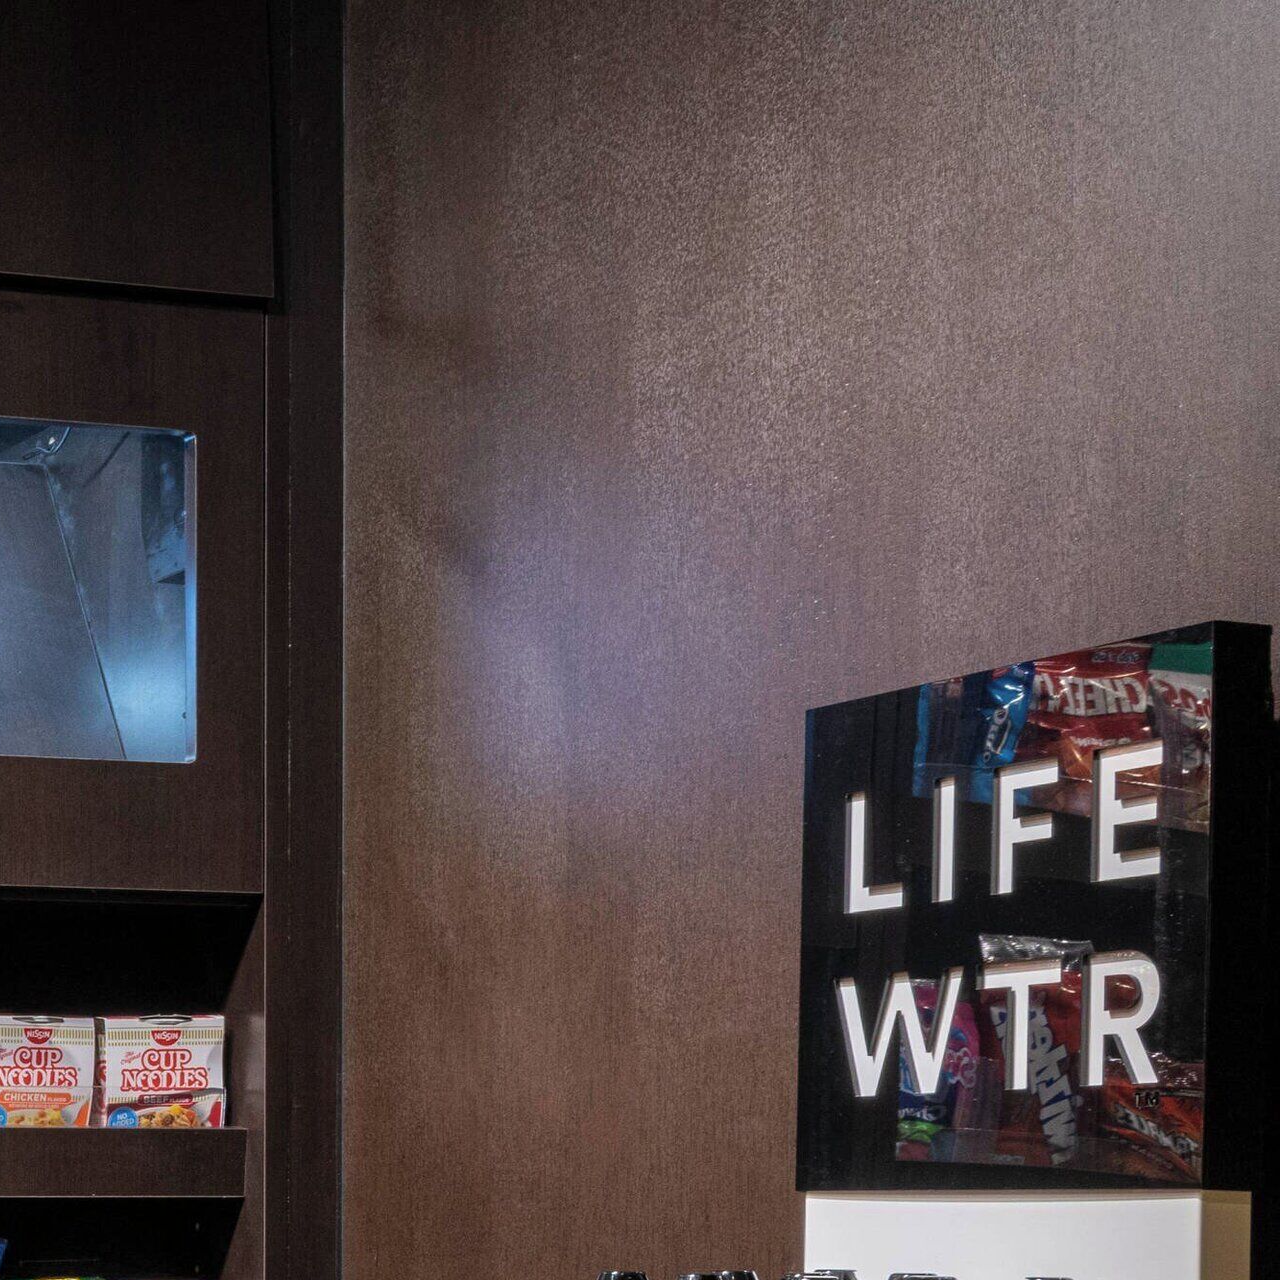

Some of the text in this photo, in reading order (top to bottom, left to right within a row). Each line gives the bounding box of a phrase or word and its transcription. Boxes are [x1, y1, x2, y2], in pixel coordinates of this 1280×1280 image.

[843, 737, 1163, 914] LIFE
[834, 951, 1161, 1097] WTR
[14, 1048, 62, 1069] CUP
[142, 1049, 191, 1070] CUP
[121, 1067, 209, 1091] NOODLES
